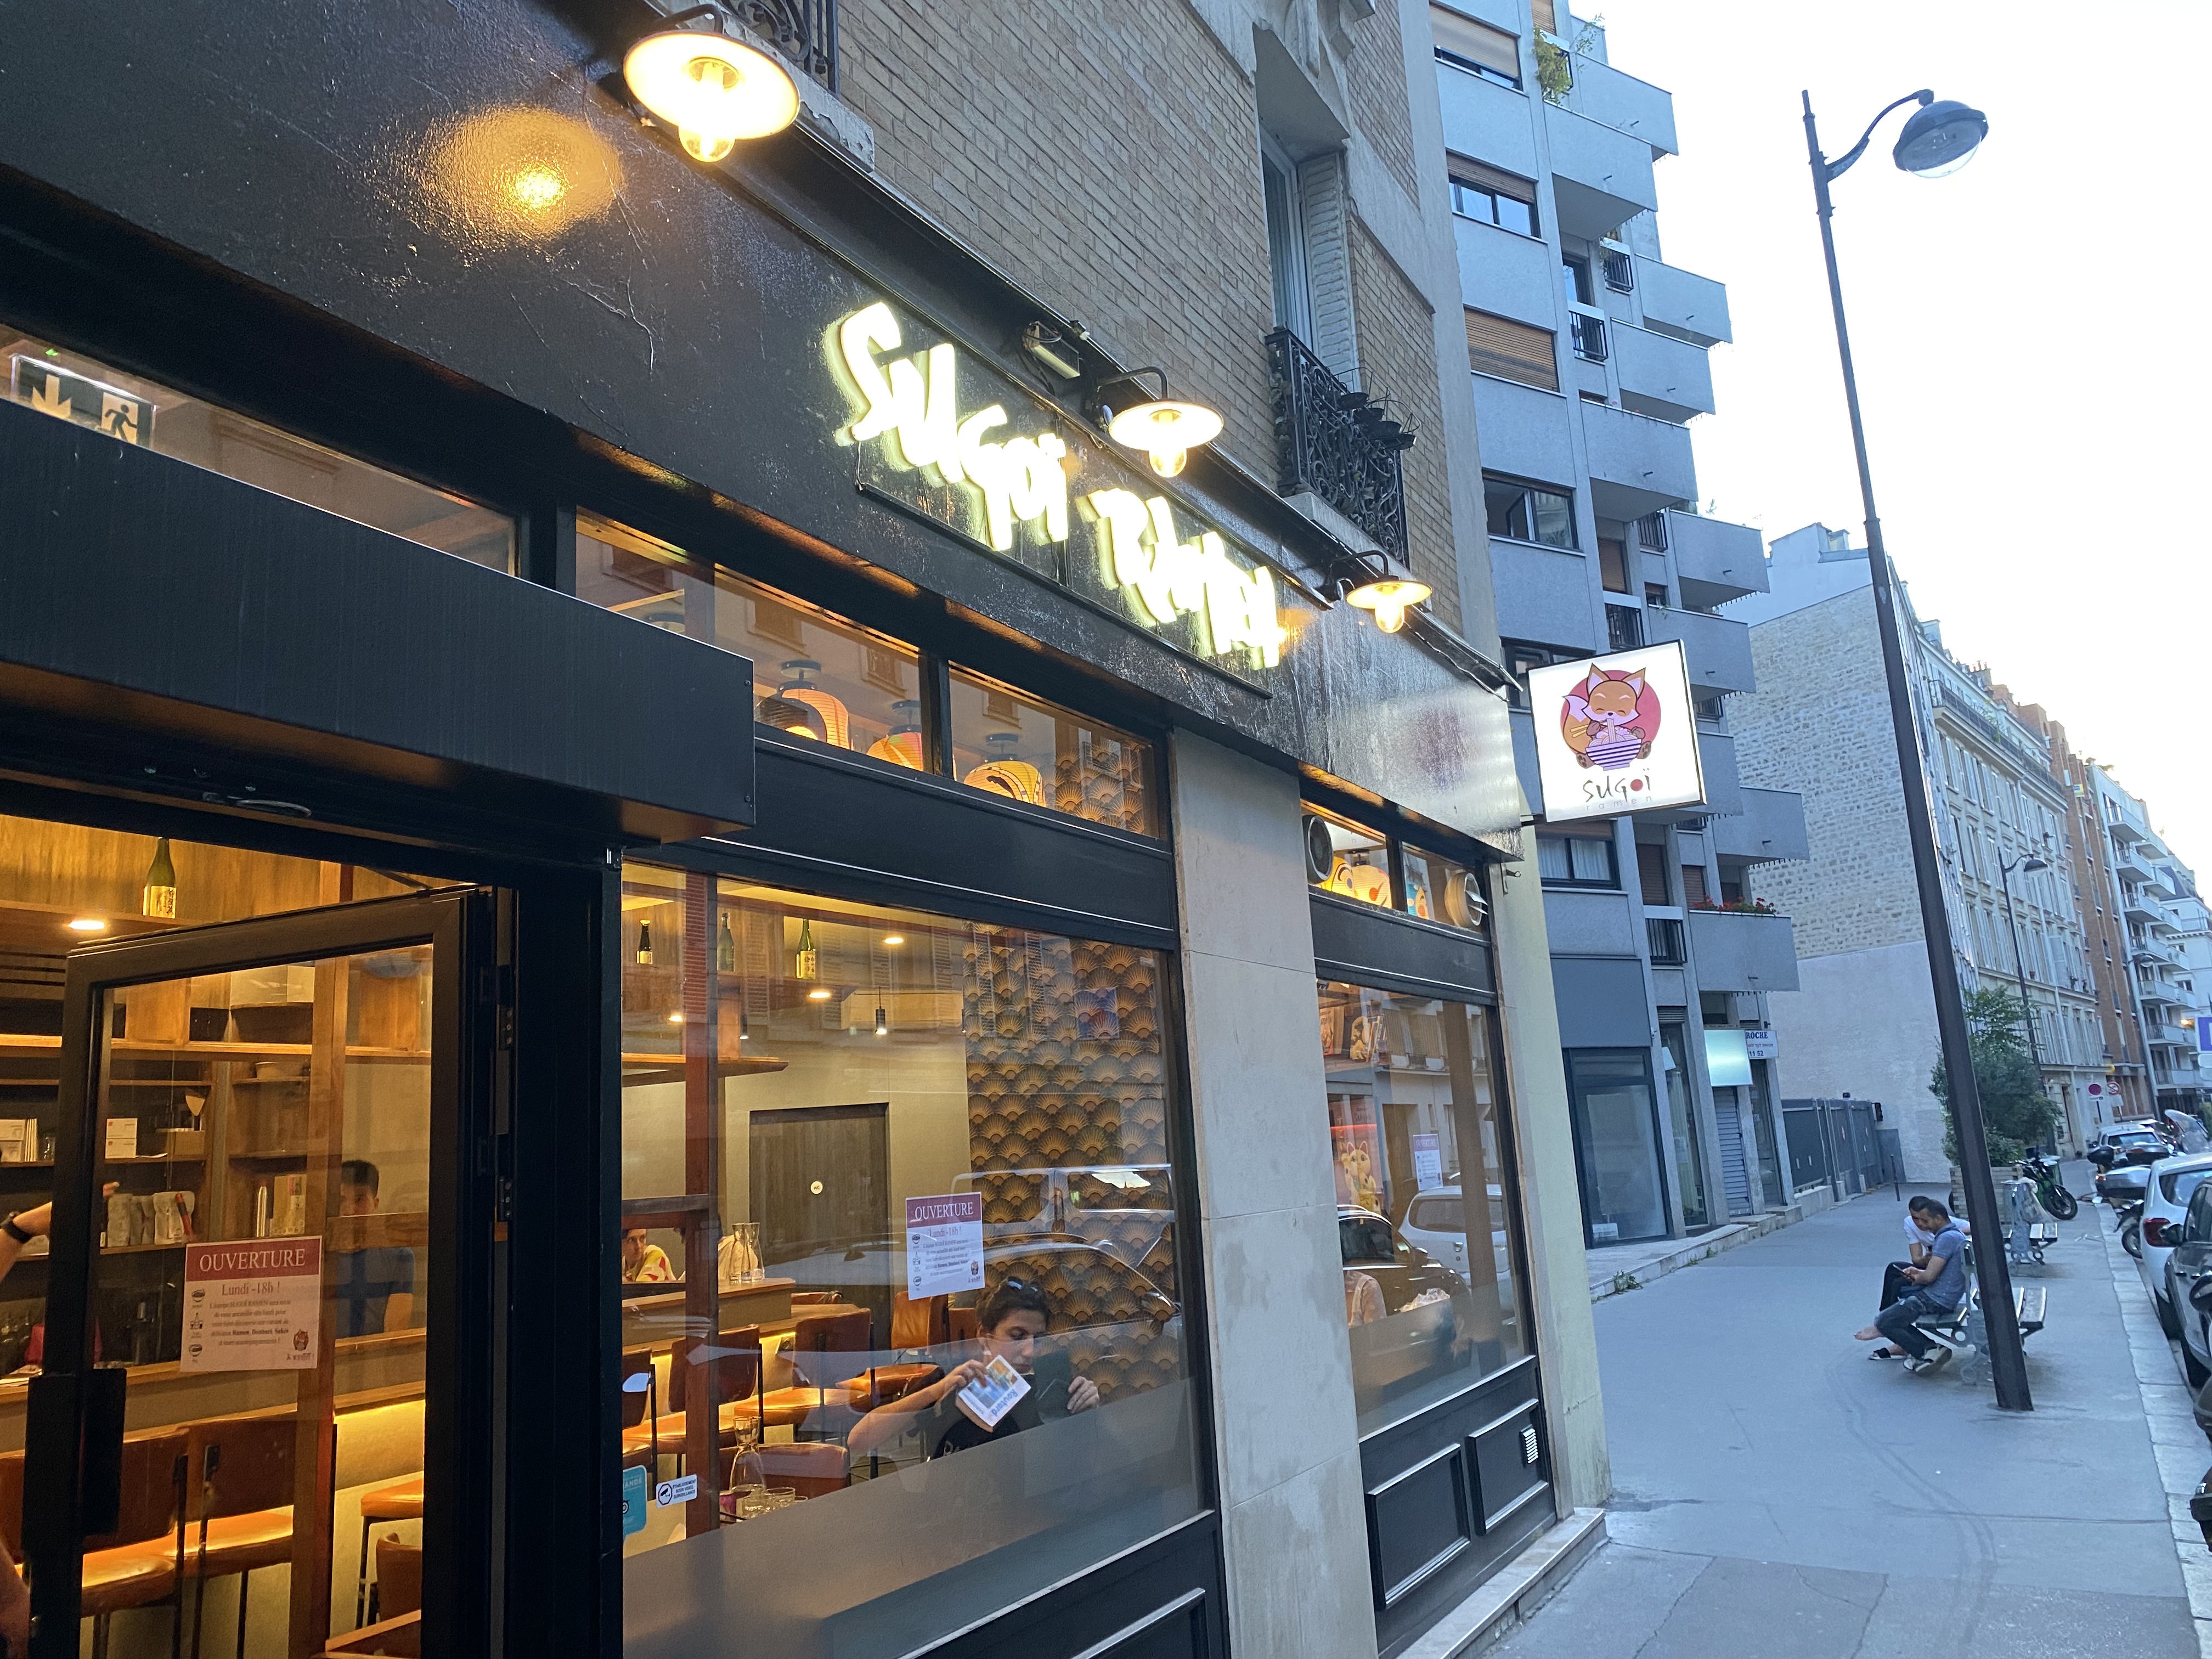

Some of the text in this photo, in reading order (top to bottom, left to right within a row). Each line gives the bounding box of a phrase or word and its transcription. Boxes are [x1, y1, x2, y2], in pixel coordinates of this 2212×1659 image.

[1587, 795, 1652, 811] ramen
[915, 1202, 973, 1220] OUVERTURE
[929, 1227, 945, 1238] Lundi
[200, 1249, 305, 1272] OUVERTURE
[222, 1283, 249, 1296] Lundi
[991, 1389, 1018, 1417] Routard
